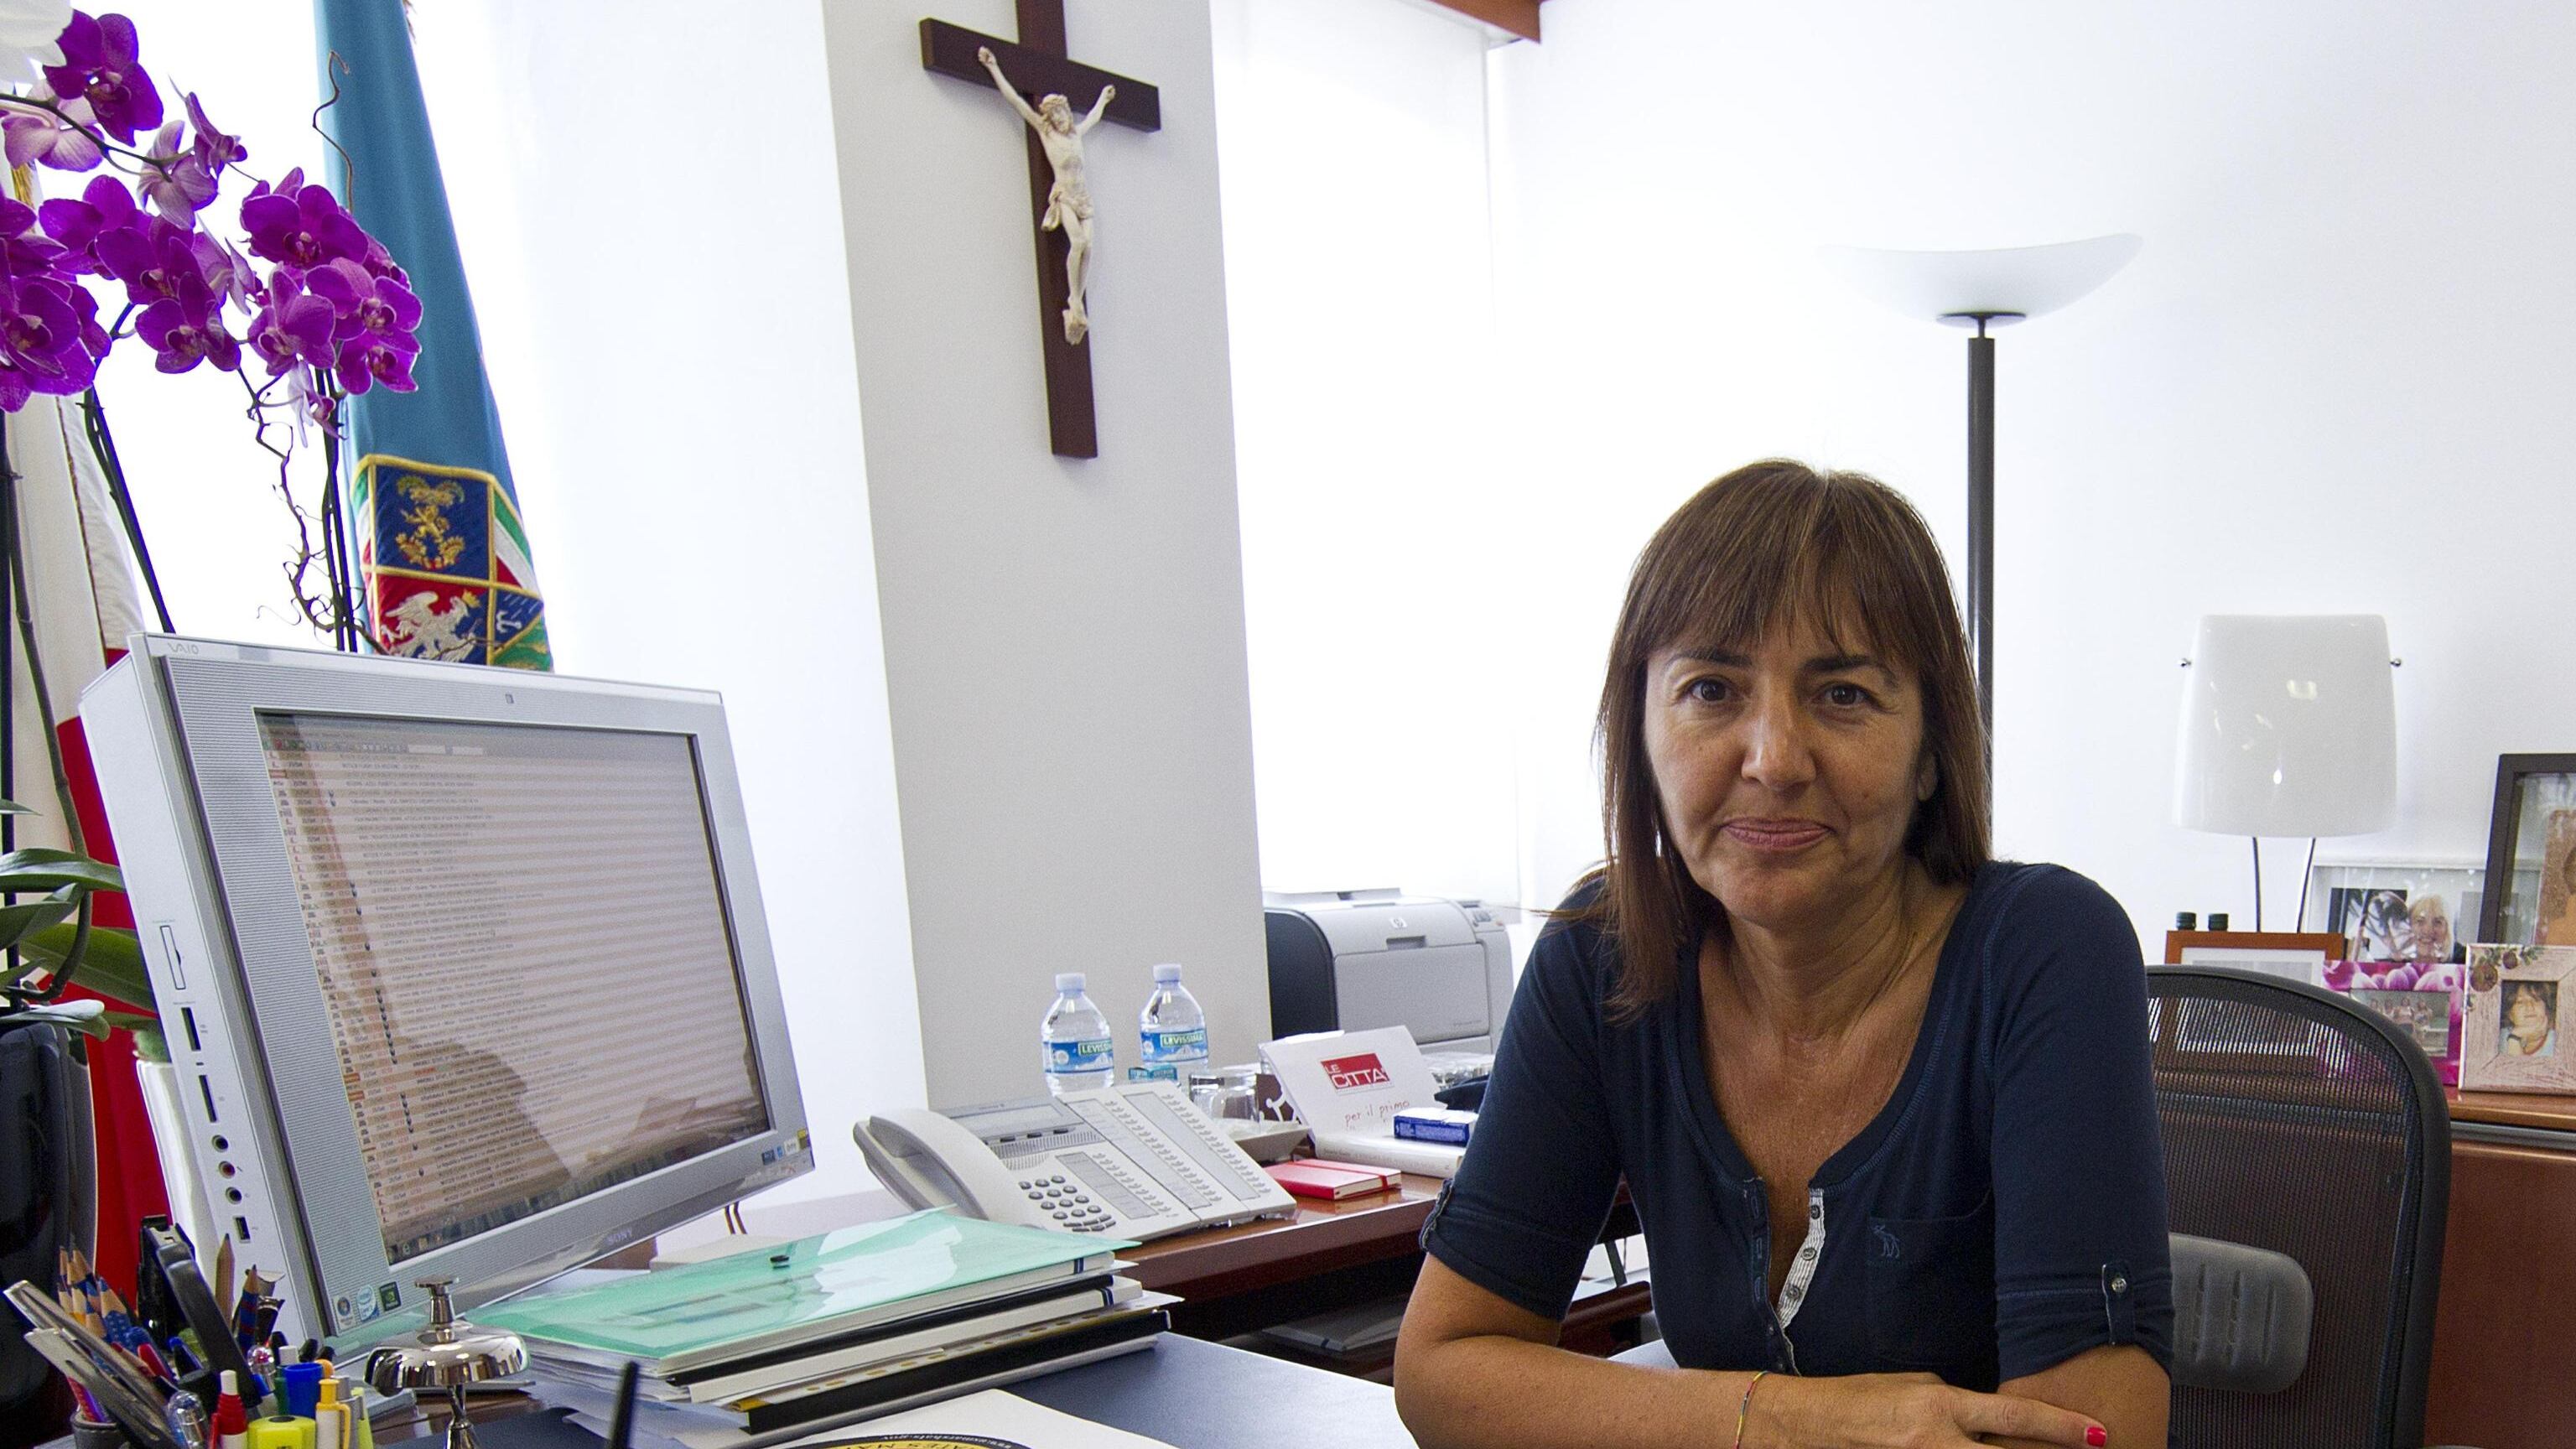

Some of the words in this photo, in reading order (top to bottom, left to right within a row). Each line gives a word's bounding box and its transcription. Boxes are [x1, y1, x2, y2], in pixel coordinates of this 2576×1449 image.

[168, 642, 199, 654] VAIO
[1325, 1063, 1341, 1074] LE
[1344, 1112, 1361, 1128] per
[1366, 1104, 1374, 1116] il
[1379, 1099, 1410, 1119] primo
